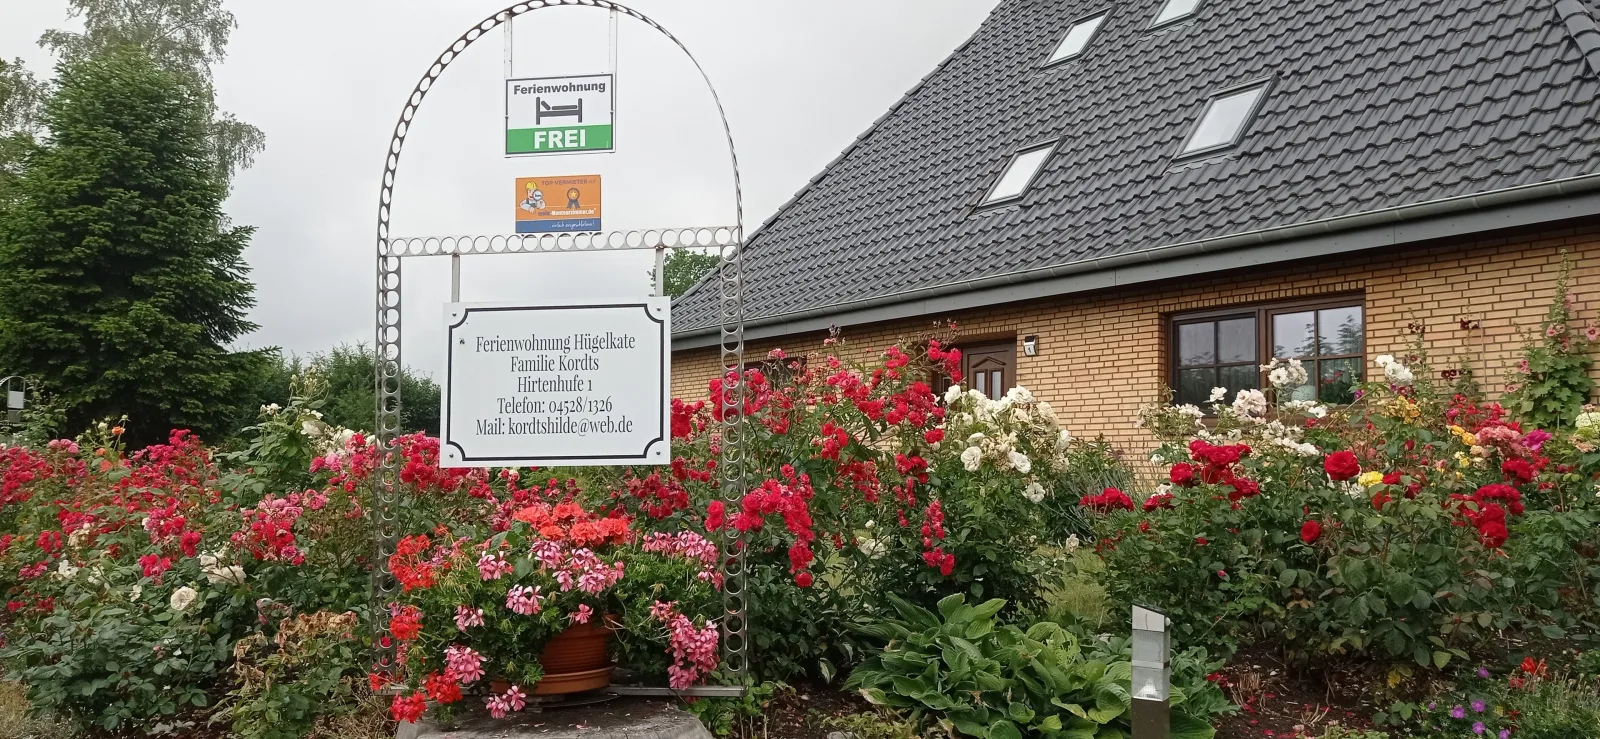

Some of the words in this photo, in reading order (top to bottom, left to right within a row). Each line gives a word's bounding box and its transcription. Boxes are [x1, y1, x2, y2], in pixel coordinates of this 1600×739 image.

[513, 82, 606, 95] Ferienwohnung
[534, 129, 586, 149] FREI
[475, 334, 571, 354] Ferienwohnung
[573, 332, 636, 354] Hügelkate
[510, 355, 555, 373] Familie
[558, 354, 600, 372] Kordts
[517, 375, 584, 393] Hirtenhufe
[587, 379, 593, 391] 1
[497, 397, 545, 414] Telefon:
[548, 396, 613, 416] 04528/1326
[475, 418, 505, 436] Mail:
[508, 415, 633, 437] kordtshilde@web.de
